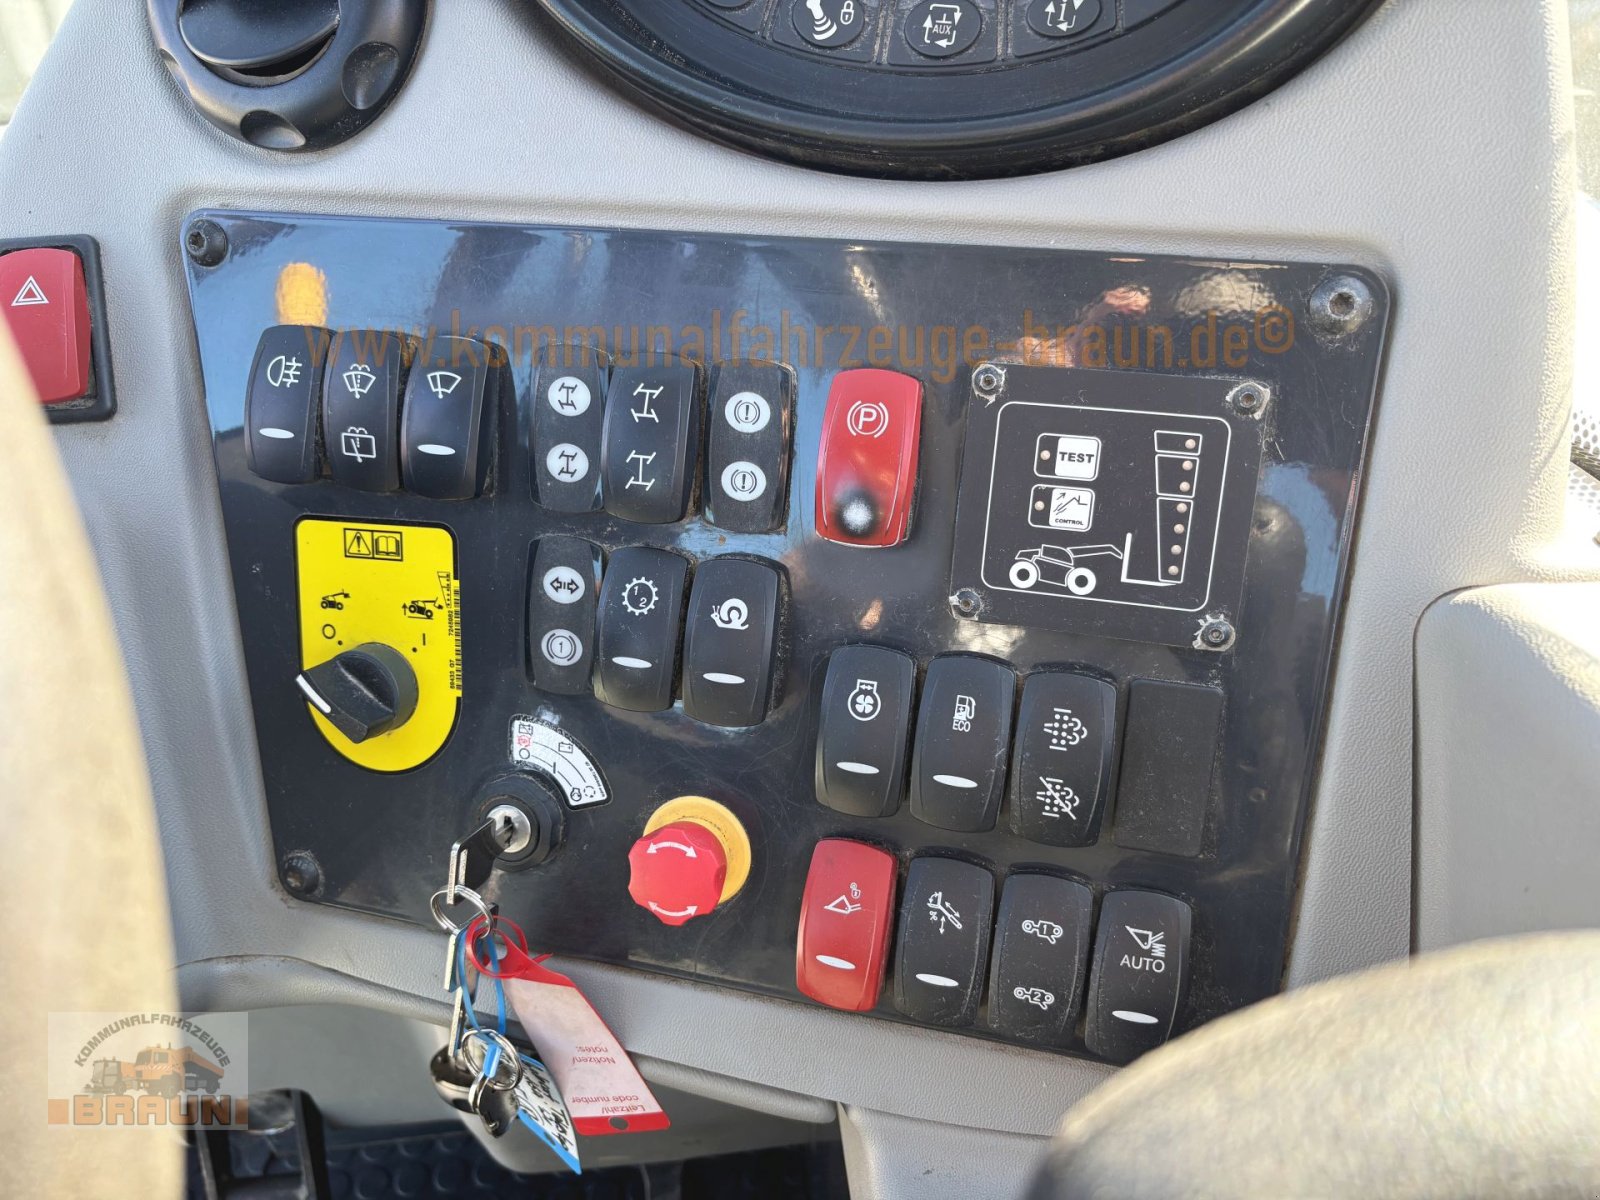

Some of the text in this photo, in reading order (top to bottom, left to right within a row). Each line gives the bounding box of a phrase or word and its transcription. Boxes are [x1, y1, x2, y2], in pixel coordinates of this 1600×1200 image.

[932, 23, 953, 36] AUX
[857, 407, 878, 430] P
[1058, 451, 1095, 464] TEST
[1054, 517, 1084, 526] CONTROL
[952, 719, 971, 733] ECO
[1120, 954, 1165, 973] AUTO
[572, 1094, 639, 1104] code number
